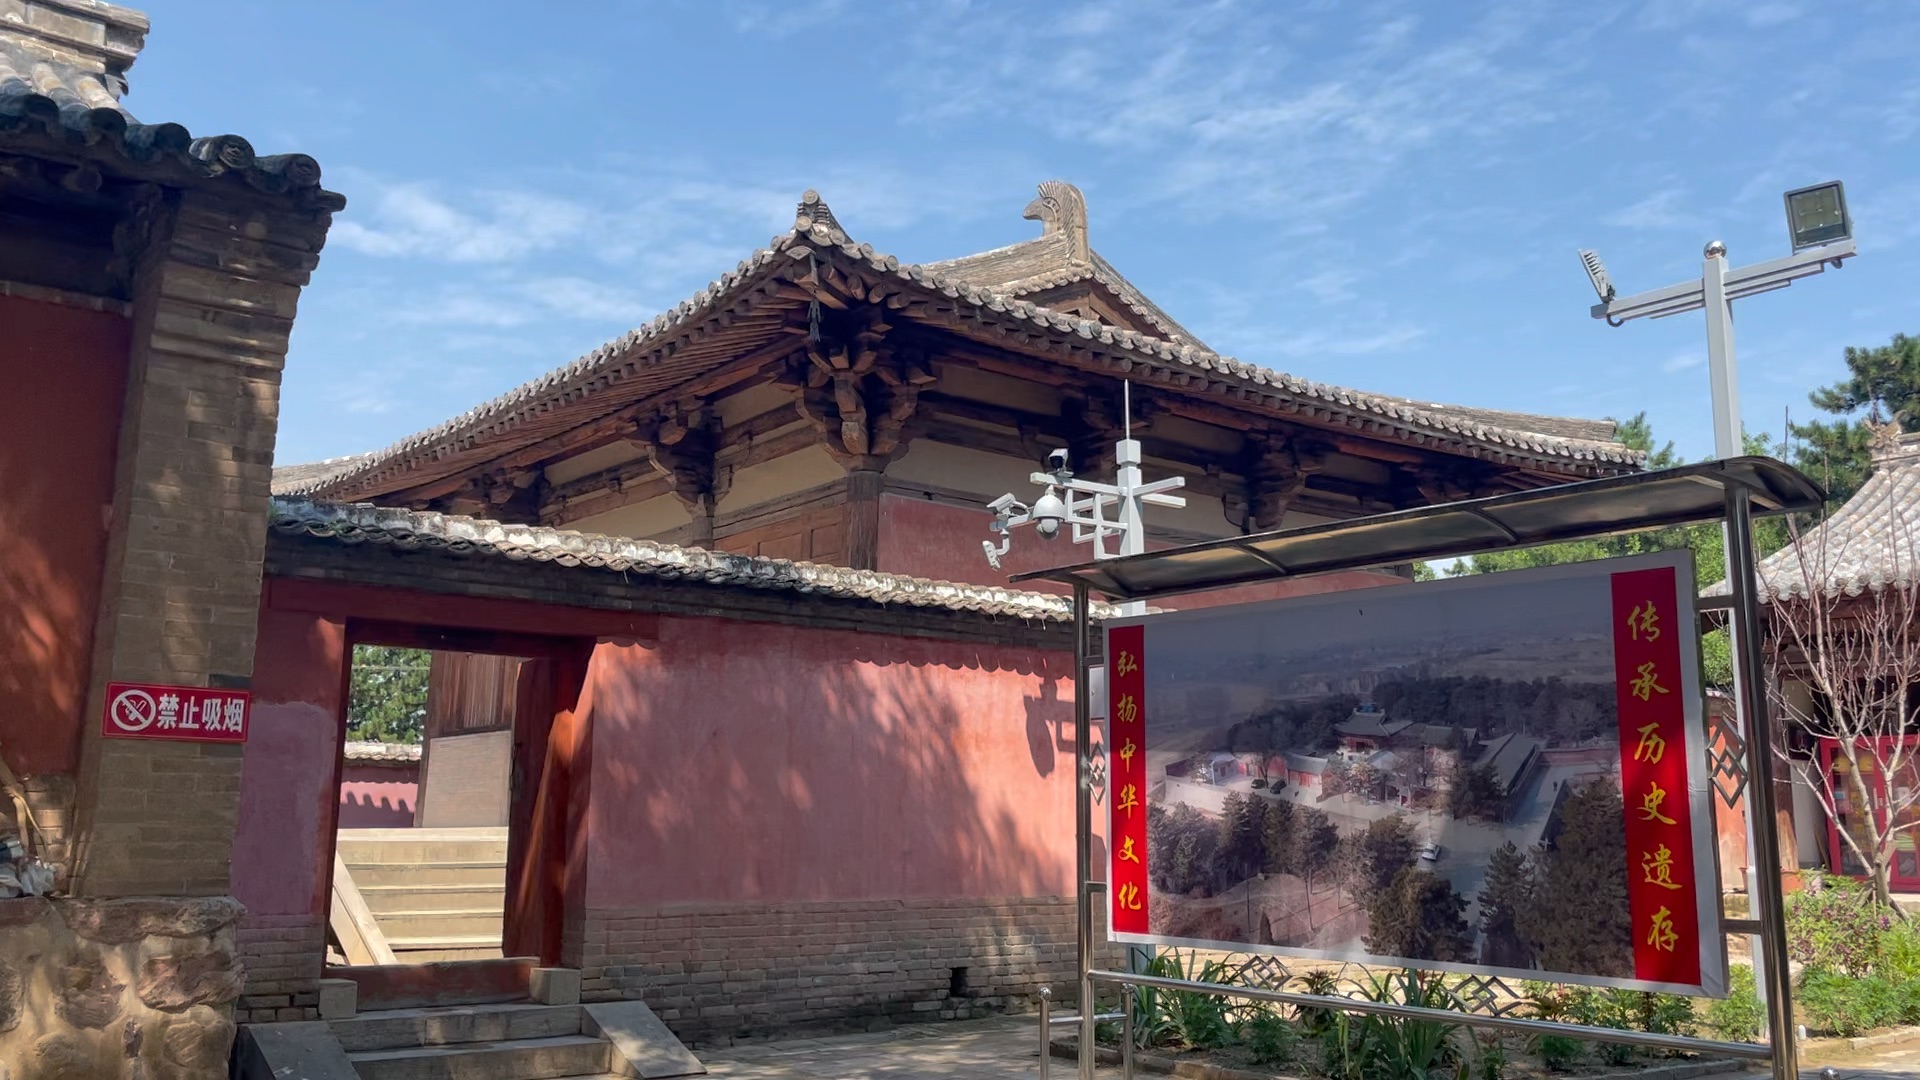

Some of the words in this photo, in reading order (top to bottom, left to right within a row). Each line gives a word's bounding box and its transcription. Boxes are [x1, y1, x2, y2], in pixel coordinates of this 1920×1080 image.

[157, 693, 245, 732] 禁止吸烟
[1117, 650, 1142, 911] 弘扬中华文化
[1627, 600, 1682, 952] 传承历史遗存
